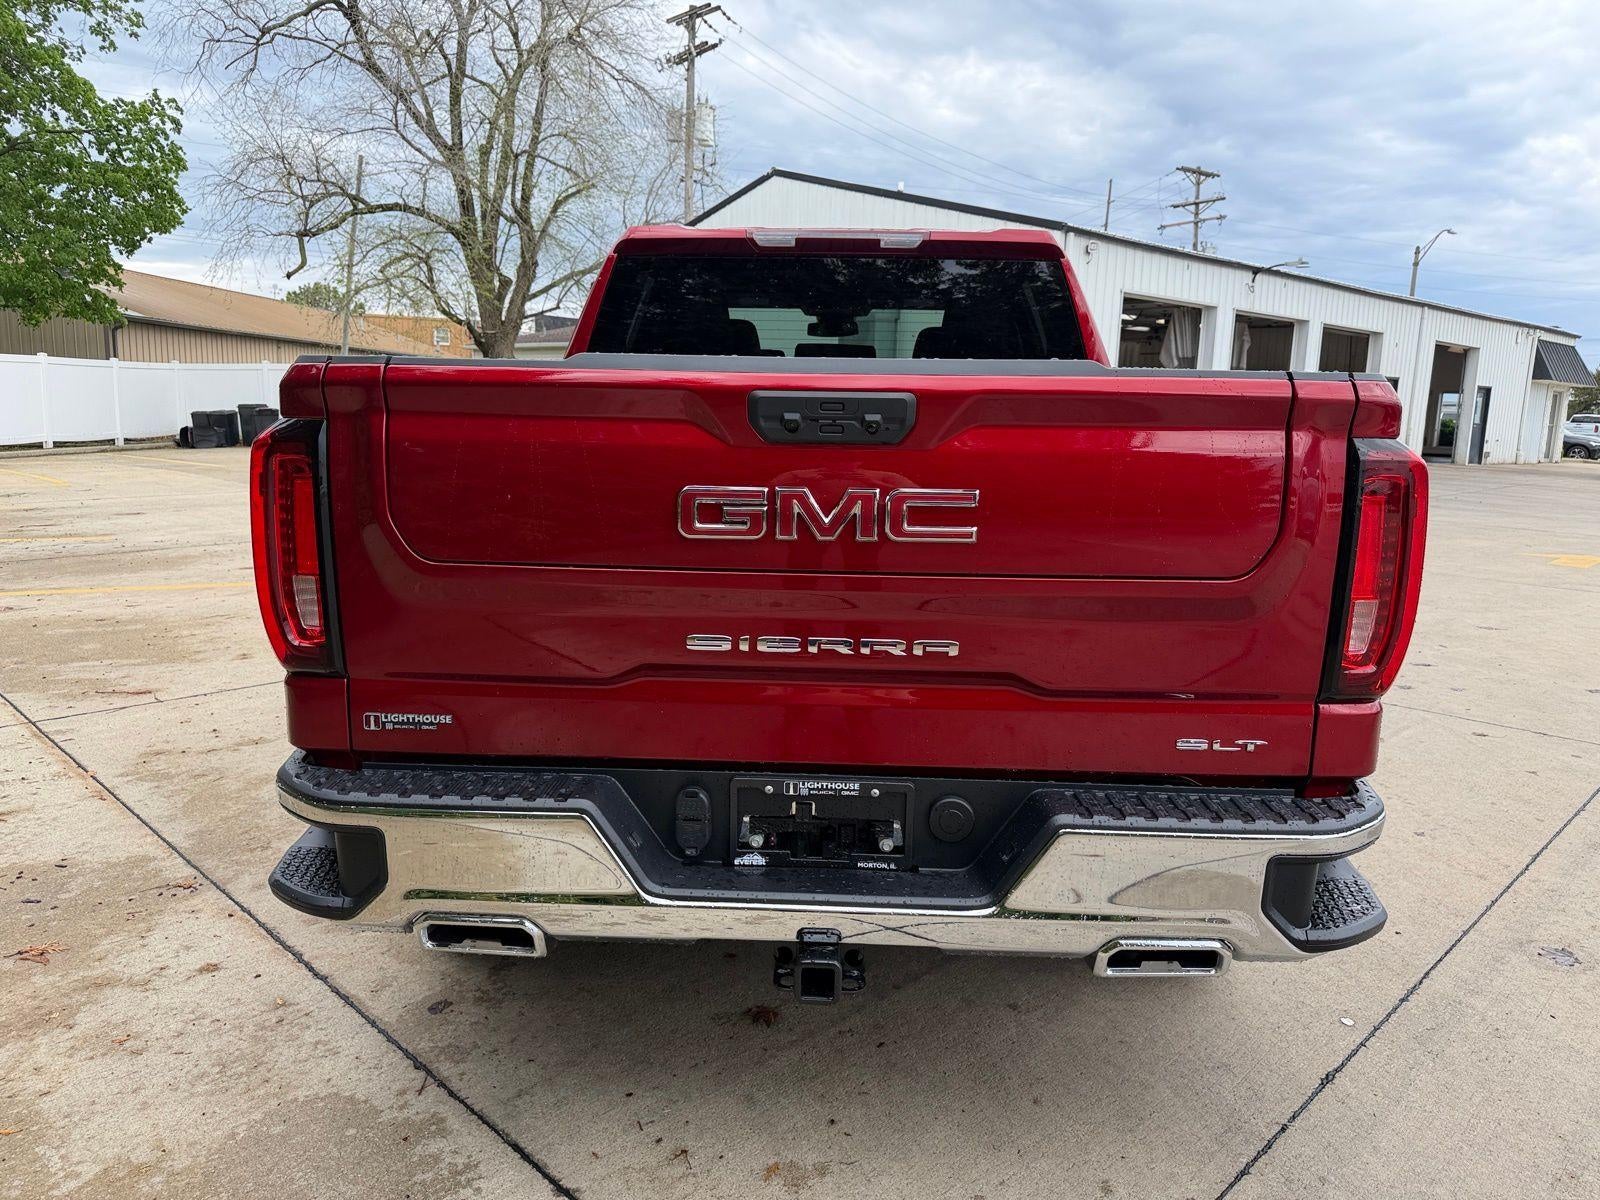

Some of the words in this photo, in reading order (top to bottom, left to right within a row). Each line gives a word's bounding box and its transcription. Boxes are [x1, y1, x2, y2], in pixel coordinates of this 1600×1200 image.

[677, 484, 980, 544] GMC
[686, 634, 960, 657] SIERRA
[381, 713, 453, 724] LIGHTHOUSE
[1175, 738, 1268, 752] SLT
[799, 781, 860, 790] LIGHTHOUSE
[857, 862, 889, 870] MORTON,
